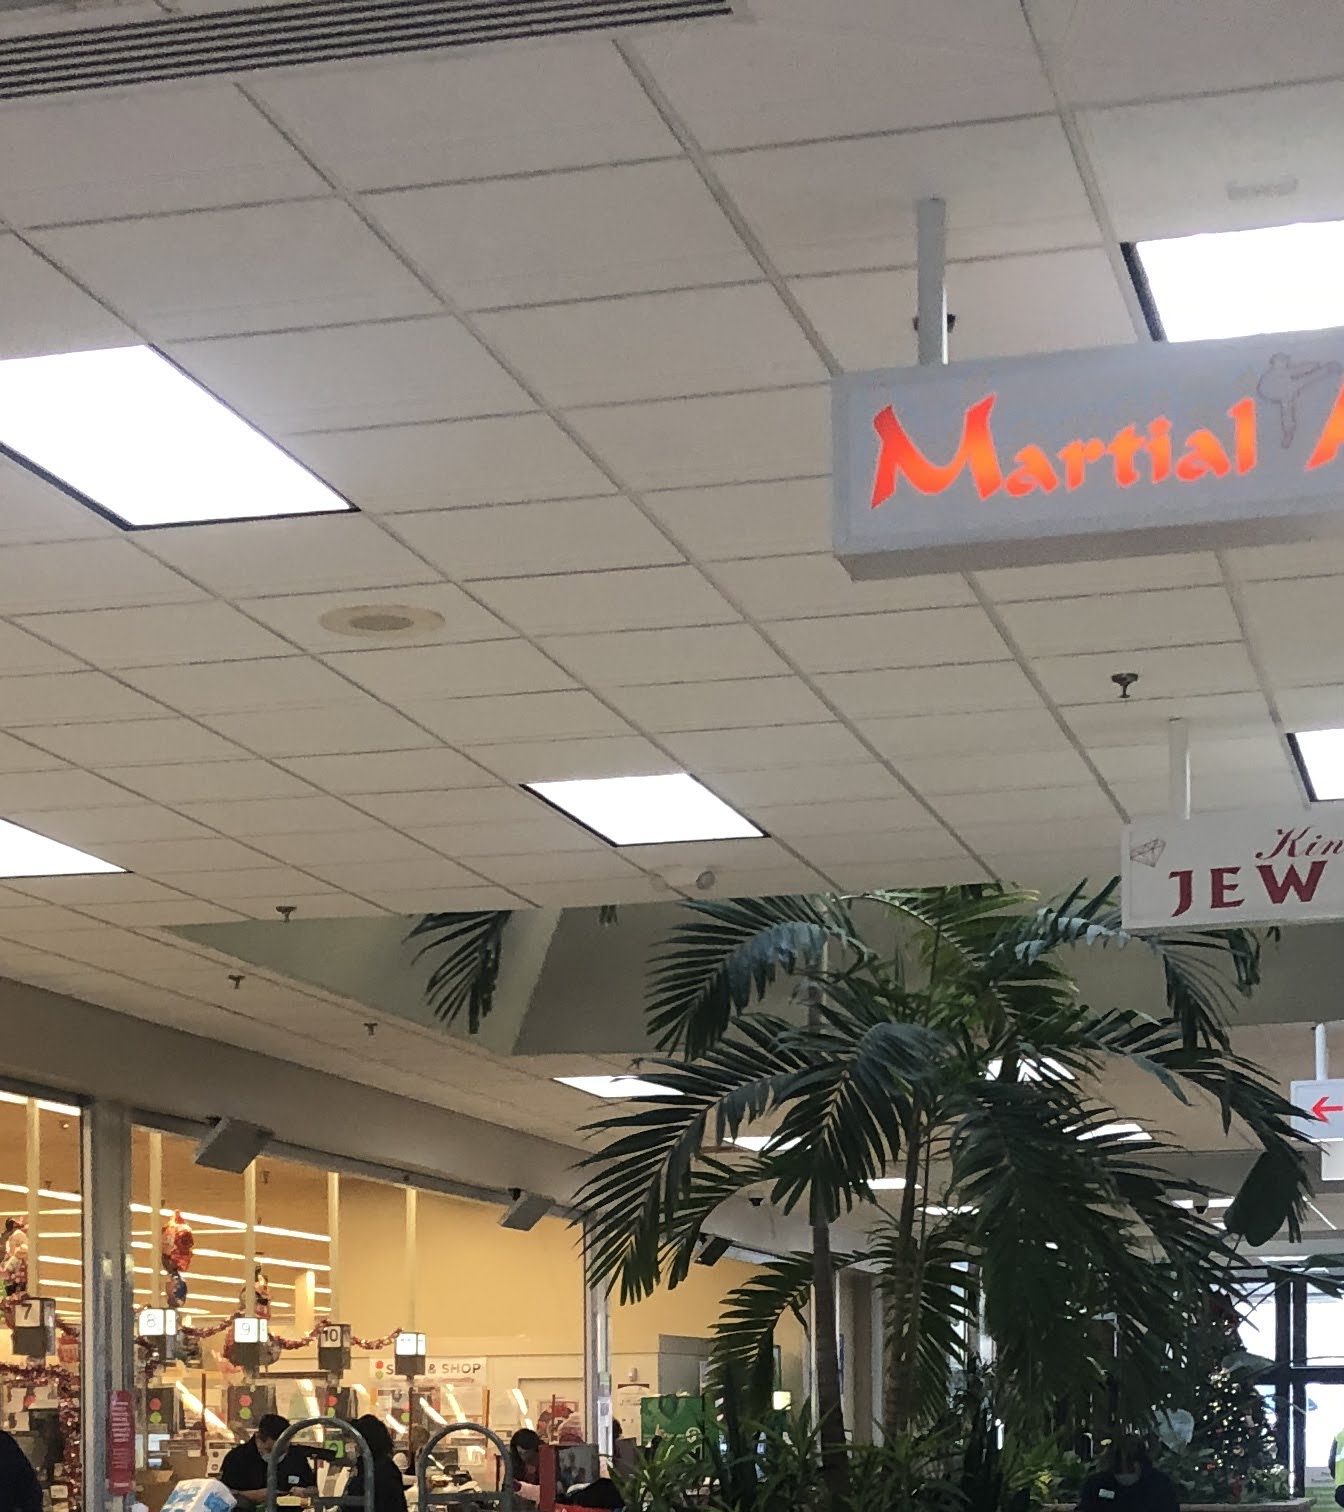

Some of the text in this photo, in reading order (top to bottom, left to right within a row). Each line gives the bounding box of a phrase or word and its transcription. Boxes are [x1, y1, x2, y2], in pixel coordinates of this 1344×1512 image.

[870, 393, 1256, 510] Martial
[22, 1303, 33, 1320] 7
[241, 1321, 251, 1336] 9
[322, 1328, 339, 1343] 10
[427, 1363, 482, 1375] & SHOP
